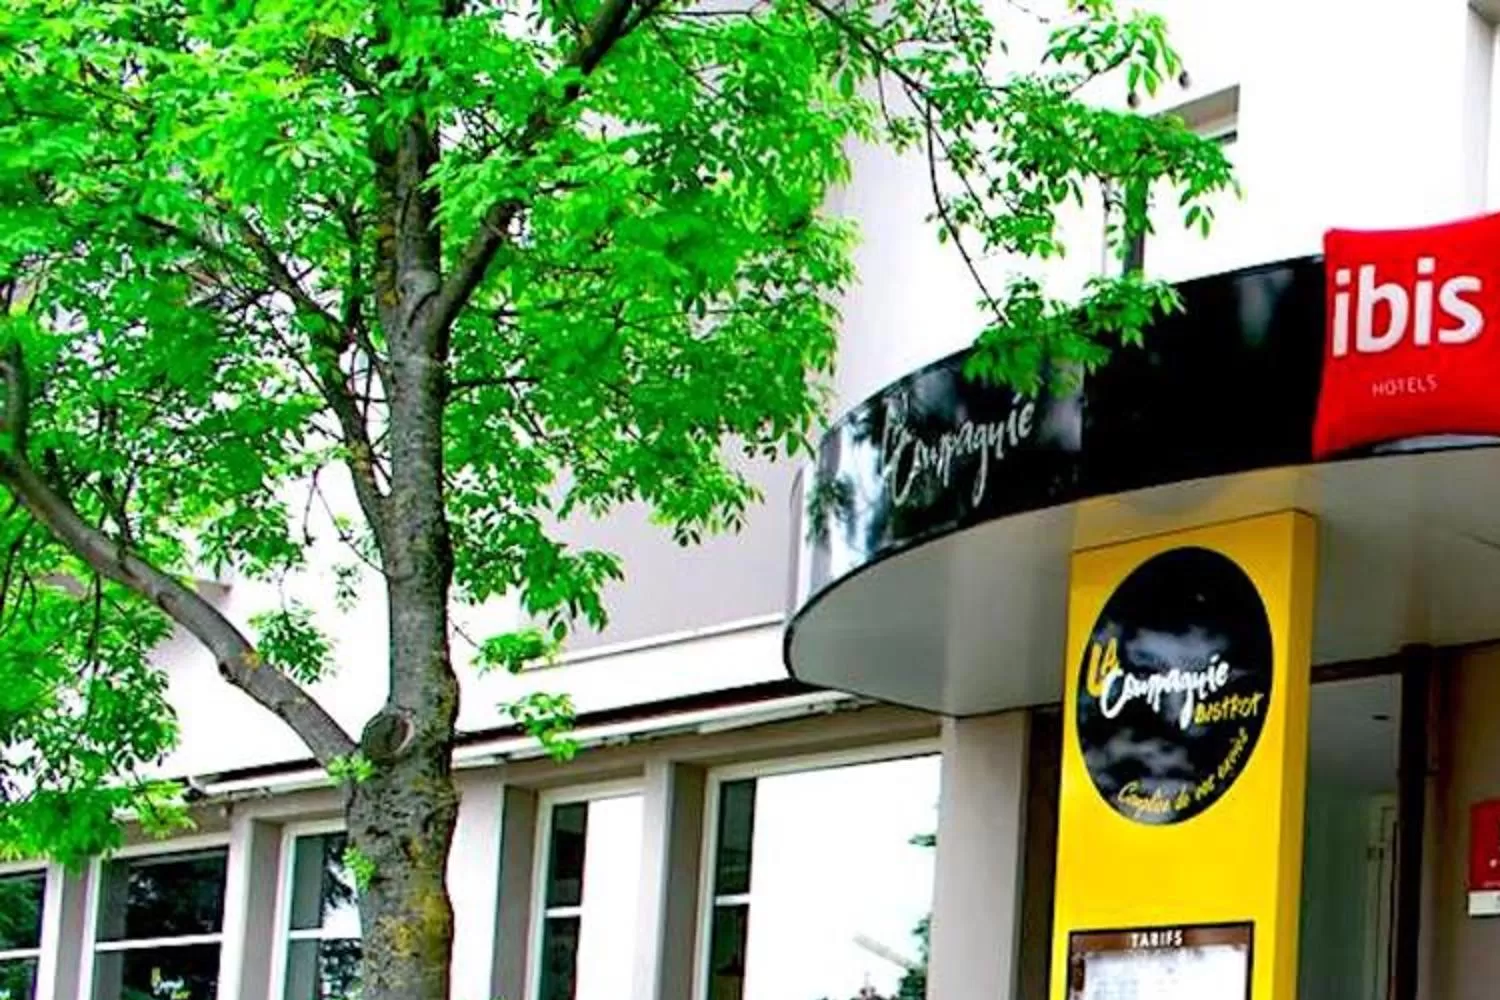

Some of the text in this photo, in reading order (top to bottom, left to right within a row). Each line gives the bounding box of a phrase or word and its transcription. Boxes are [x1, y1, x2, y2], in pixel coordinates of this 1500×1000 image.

[1332, 256, 1485, 358] ibis
[1371, 374, 1438, 396] HOTELS
[1131, 930, 1183, 947] TARIFS
